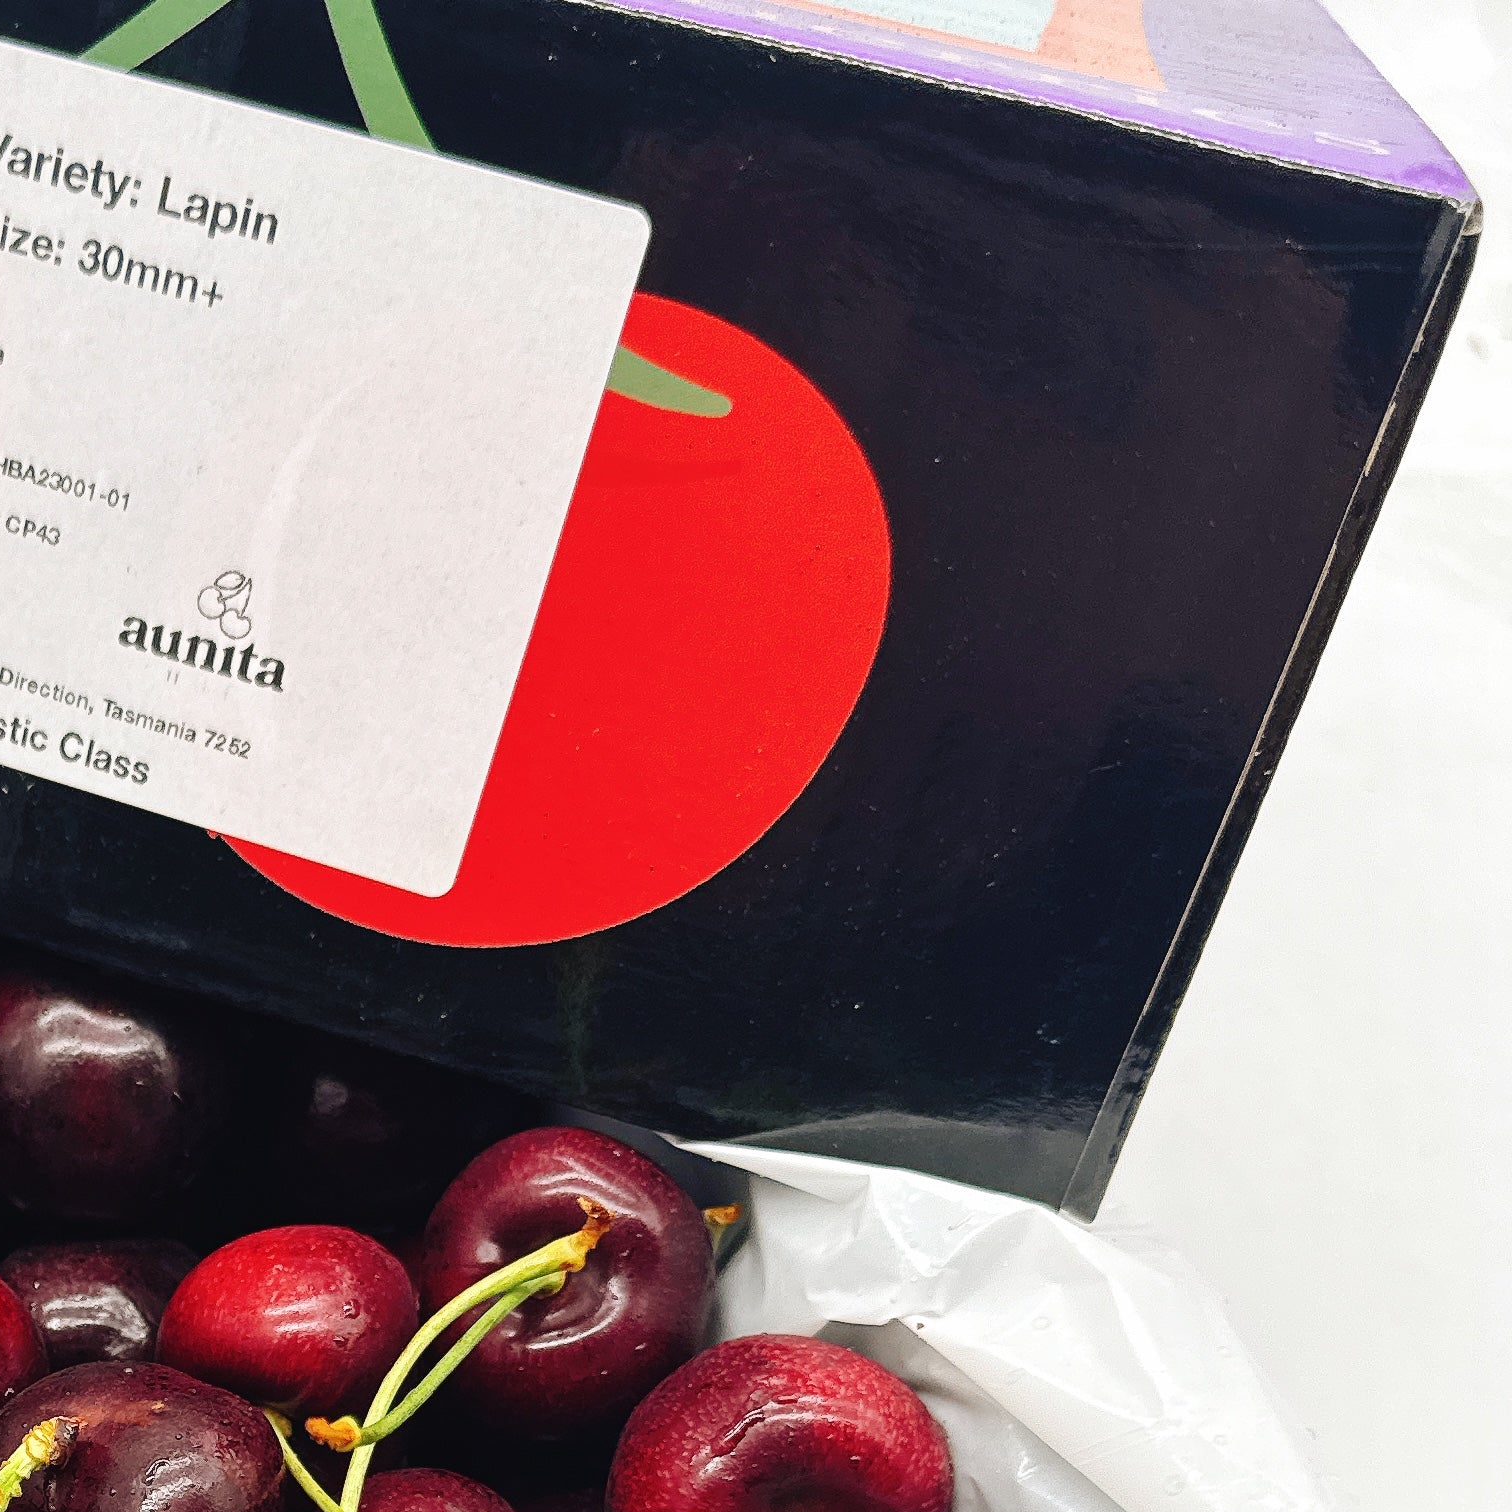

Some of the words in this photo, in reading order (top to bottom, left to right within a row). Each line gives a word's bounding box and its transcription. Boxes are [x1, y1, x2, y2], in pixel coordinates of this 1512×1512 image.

[155, 174, 279, 245] Lapin
[76, 237, 224, 308] 30mm+
[4, 513, 61, 546] CP43
[116, 614, 286, 693] aunita
[57, 729, 150, 786] Class
[102, 696, 197, 743] Tasmania
[203, 727, 252, 760] 7252
